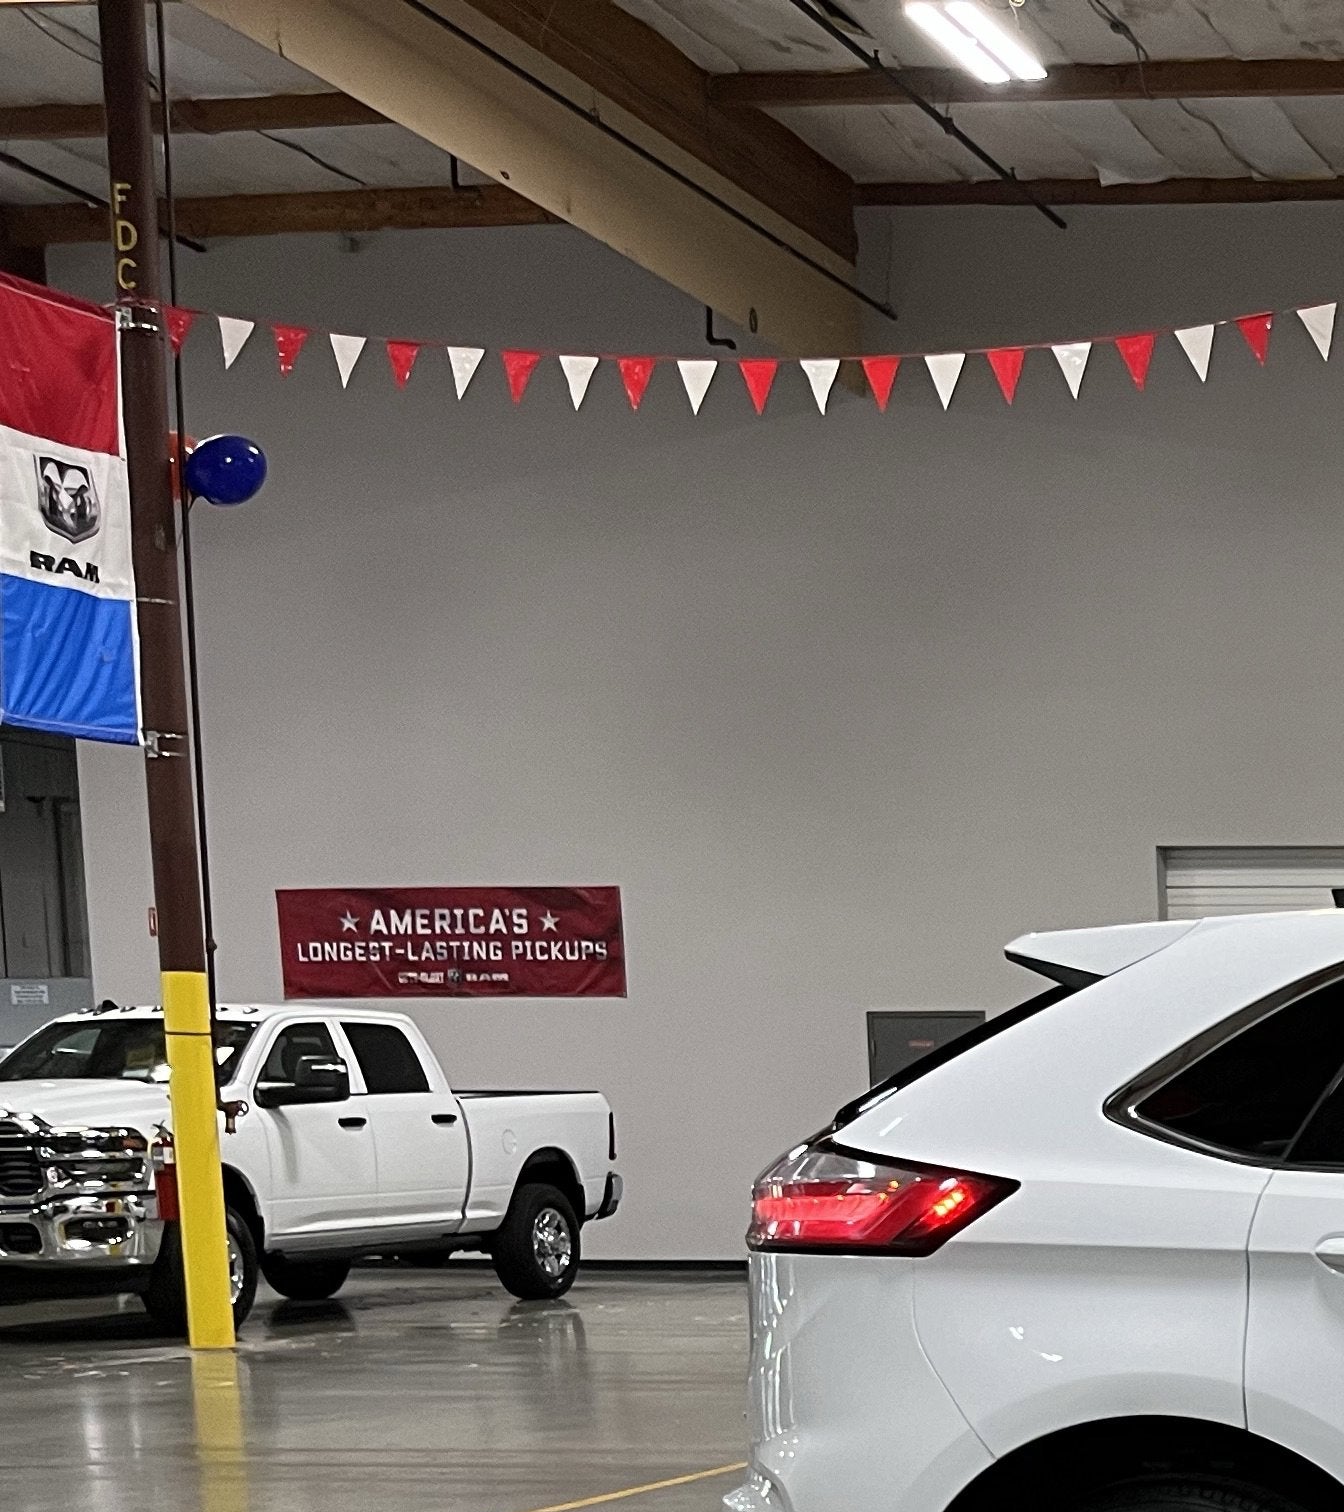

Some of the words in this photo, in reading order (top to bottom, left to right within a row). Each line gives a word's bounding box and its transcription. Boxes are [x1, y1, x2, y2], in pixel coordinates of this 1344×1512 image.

[29, 550, 100, 583] RAM
[369, 908, 529, 936] AMERICA'S
[297, 941, 503, 963] LONGEST-LASTING
[511, 940, 609, 961] PICKUPS
